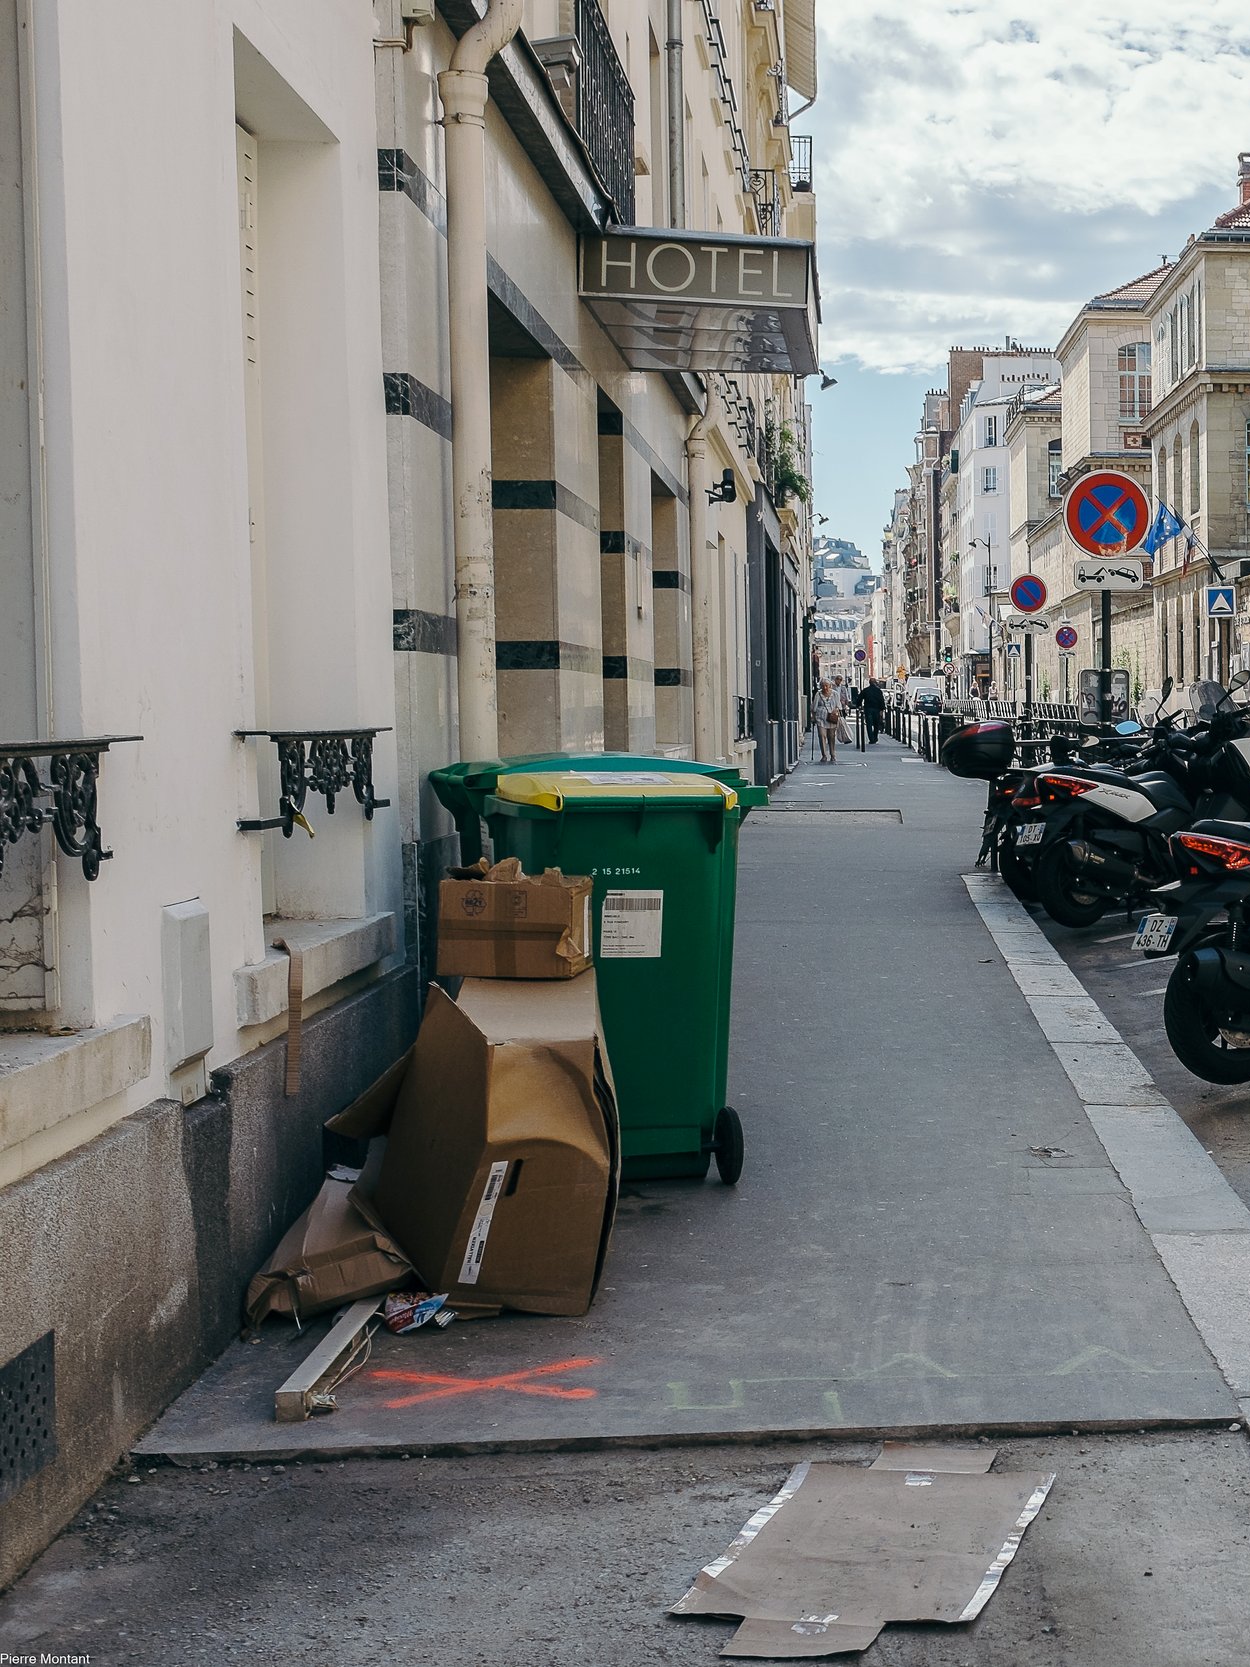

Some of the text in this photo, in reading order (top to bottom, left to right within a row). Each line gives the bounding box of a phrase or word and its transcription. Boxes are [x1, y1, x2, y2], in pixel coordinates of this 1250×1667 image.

[601, 240, 793, 298] HOTEL
[592, 868, 598, 876] 2
[615, 867, 641, 876] 21514
